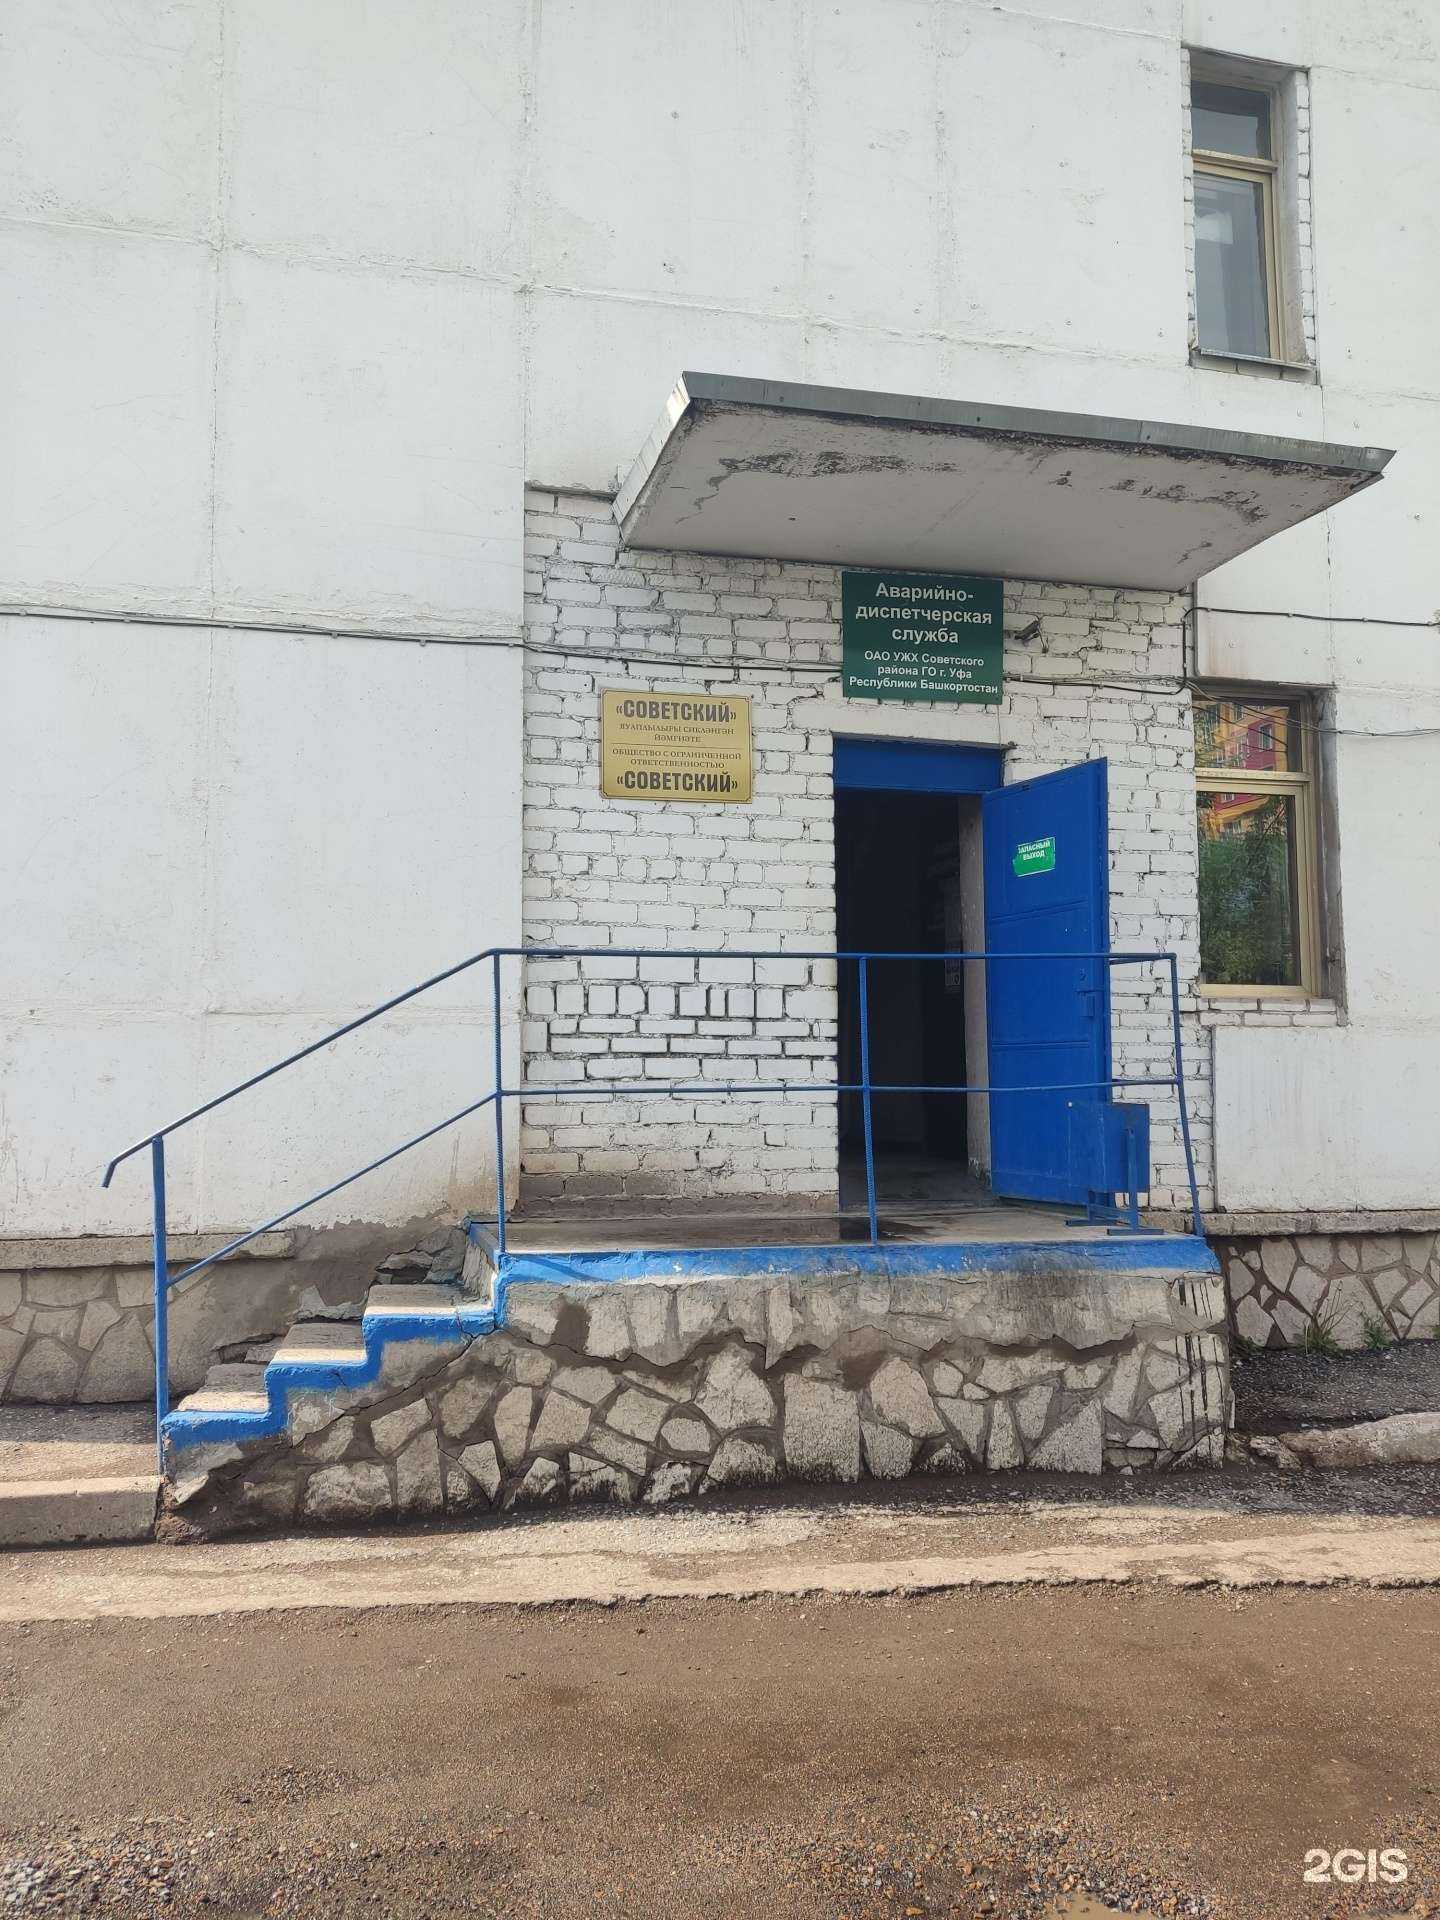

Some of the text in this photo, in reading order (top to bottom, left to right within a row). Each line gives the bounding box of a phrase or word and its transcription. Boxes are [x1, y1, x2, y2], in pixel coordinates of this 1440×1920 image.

[875, 582, 974, 602] Аварийно-
[855, 606, 992, 625] диспетчерская
[891, 627, 959, 644] служба
[864, 650, 984, 667] ОАО УЖХ Советского
[877, 664, 972, 680] района ГО г. Уфа
[849, 676, 998, 694] Республики Башкортостан
[616, 699, 737, 723] «СОВЕТСКИЙ»
[612, 748, 662, 758] ОБЩЕСТВО
[670, 750, 742, 760] ОГРАНИЧЕННОЙ
[630, 758, 725, 769] ОТВЕТСТВЕННОСТЬЮ
[616, 771, 738, 793] «СОВЕТСКИЙ»
